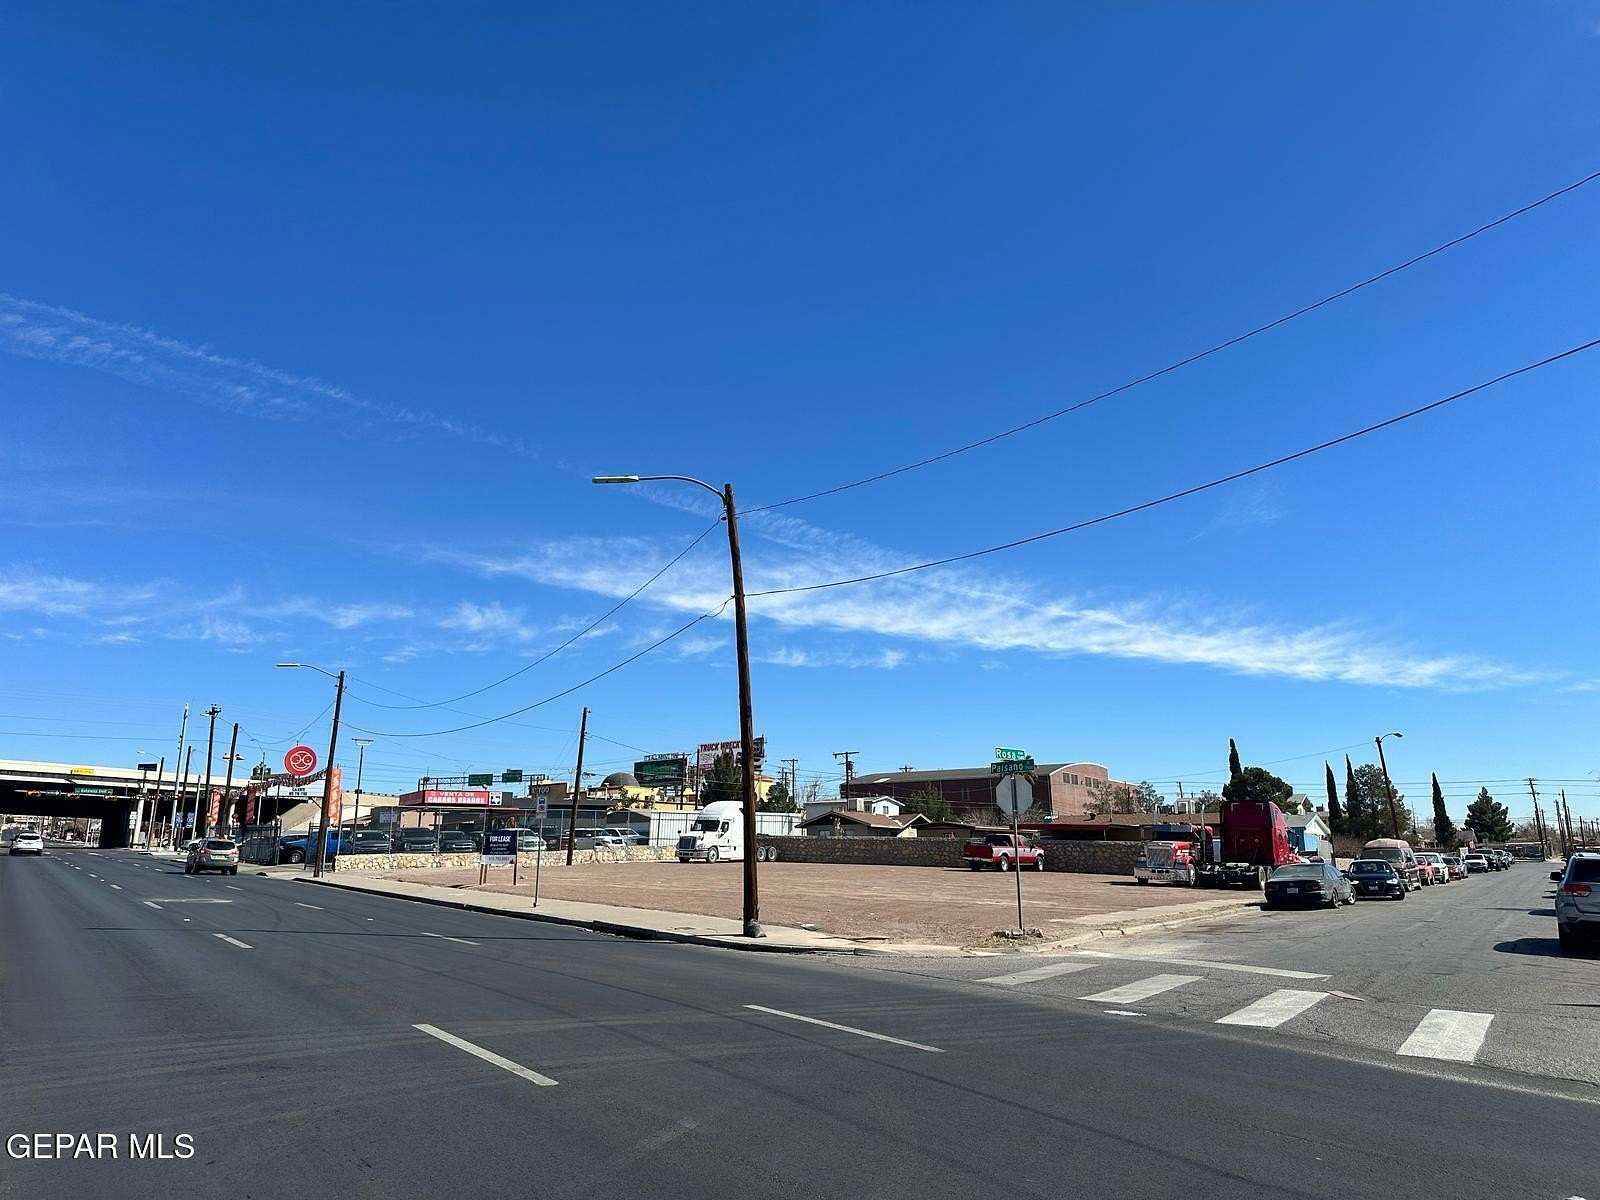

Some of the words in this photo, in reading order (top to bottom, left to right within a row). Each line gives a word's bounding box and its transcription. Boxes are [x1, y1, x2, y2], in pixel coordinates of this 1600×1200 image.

[700, 742, 720, 752] TRUCK
[720, 741, 741, 752] WRECK
[996, 749, 1016, 759] Rosa
[991, 764, 1024, 773] Paisano
